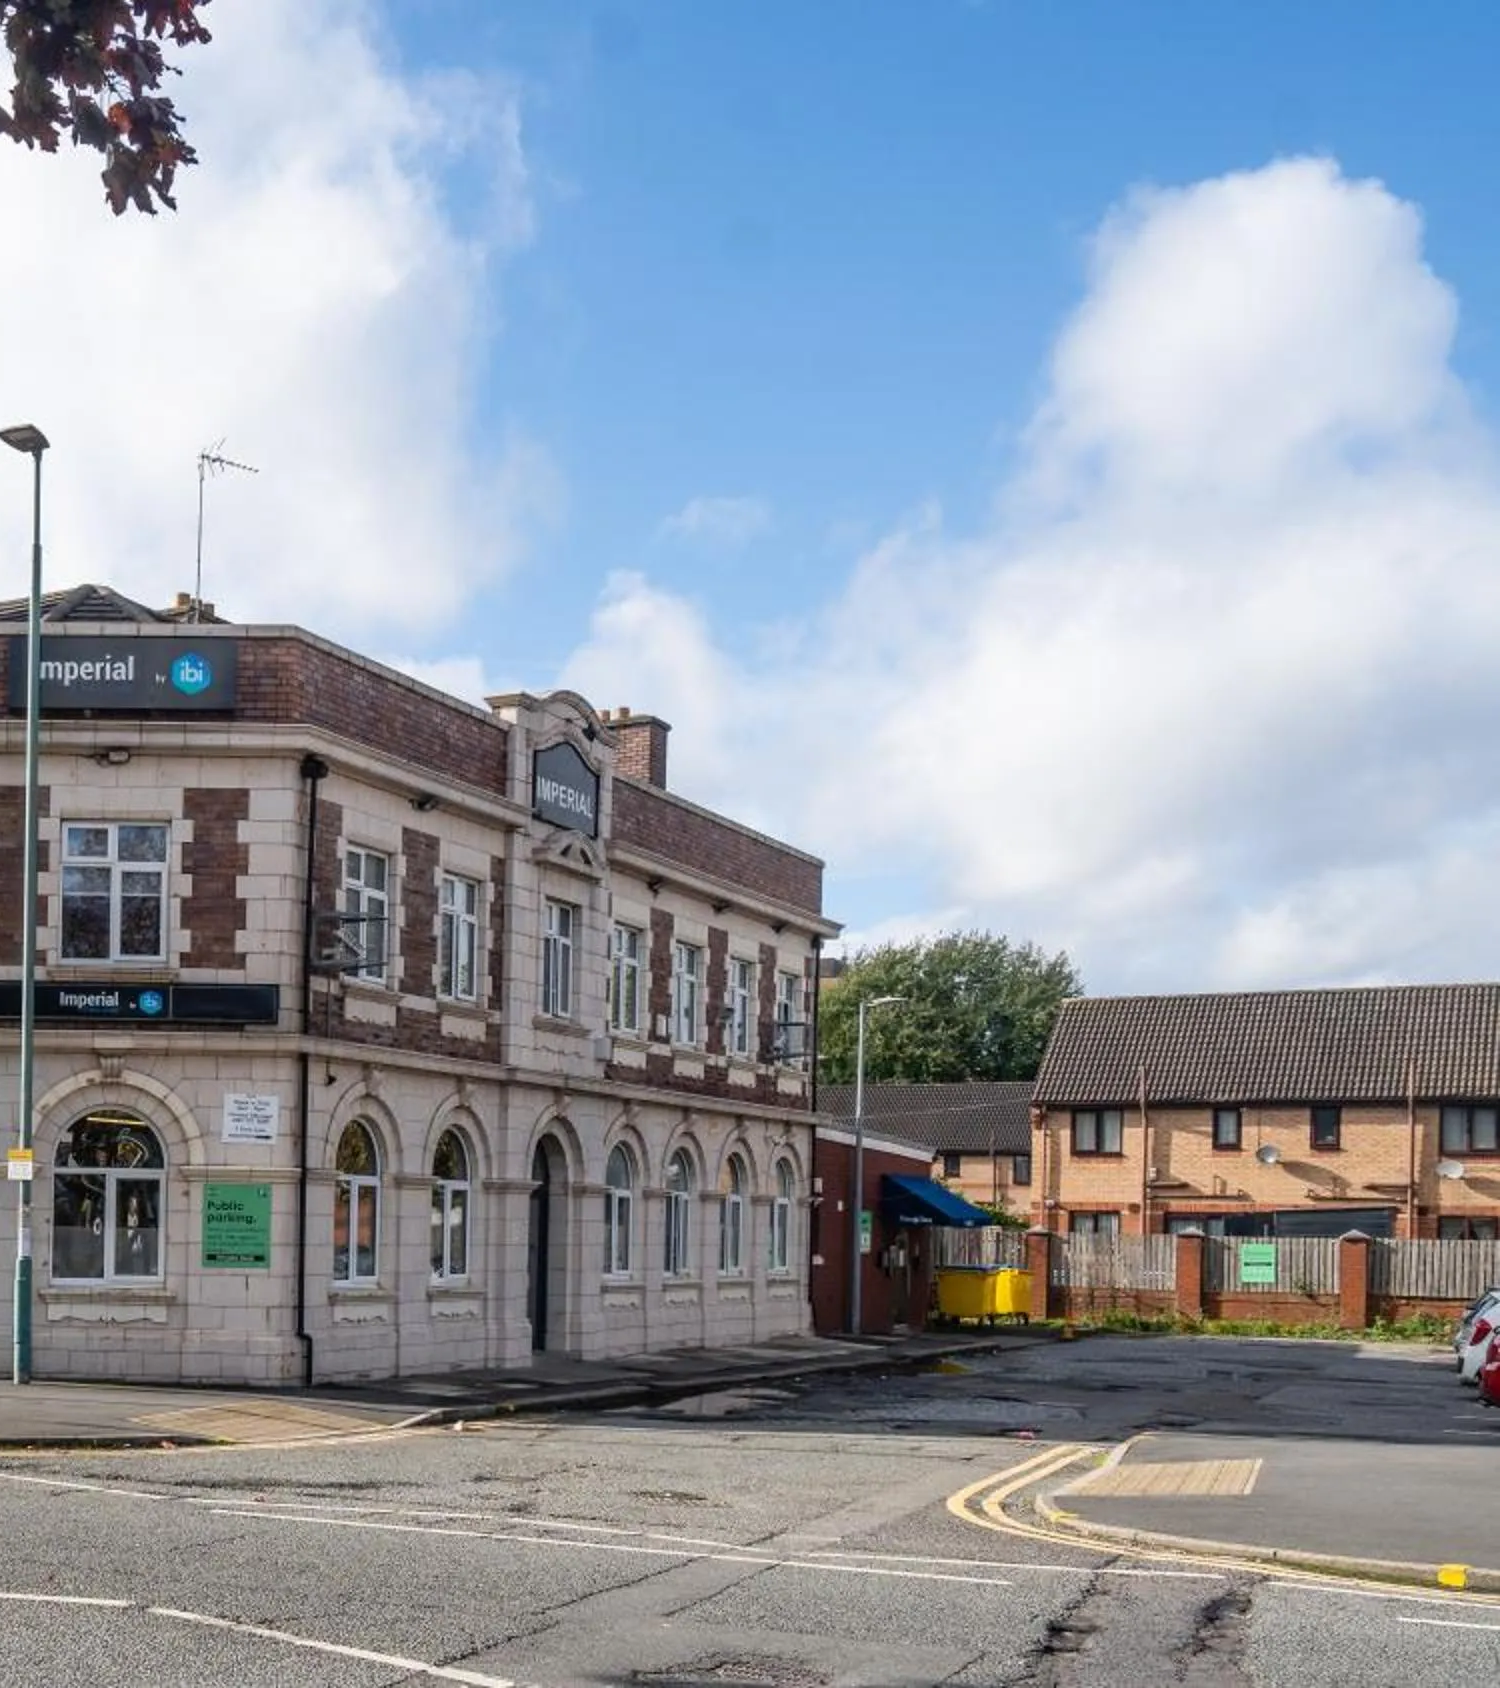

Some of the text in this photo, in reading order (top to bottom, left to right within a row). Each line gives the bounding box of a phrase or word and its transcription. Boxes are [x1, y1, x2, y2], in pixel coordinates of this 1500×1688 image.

[39, 654, 134, 686] mperial
[180, 660, 203, 682] ibi
[536, 776, 593, 819] IMPERIAL
[59, 991, 119, 1009] Imperial
[207, 1199, 245, 1211] Public
